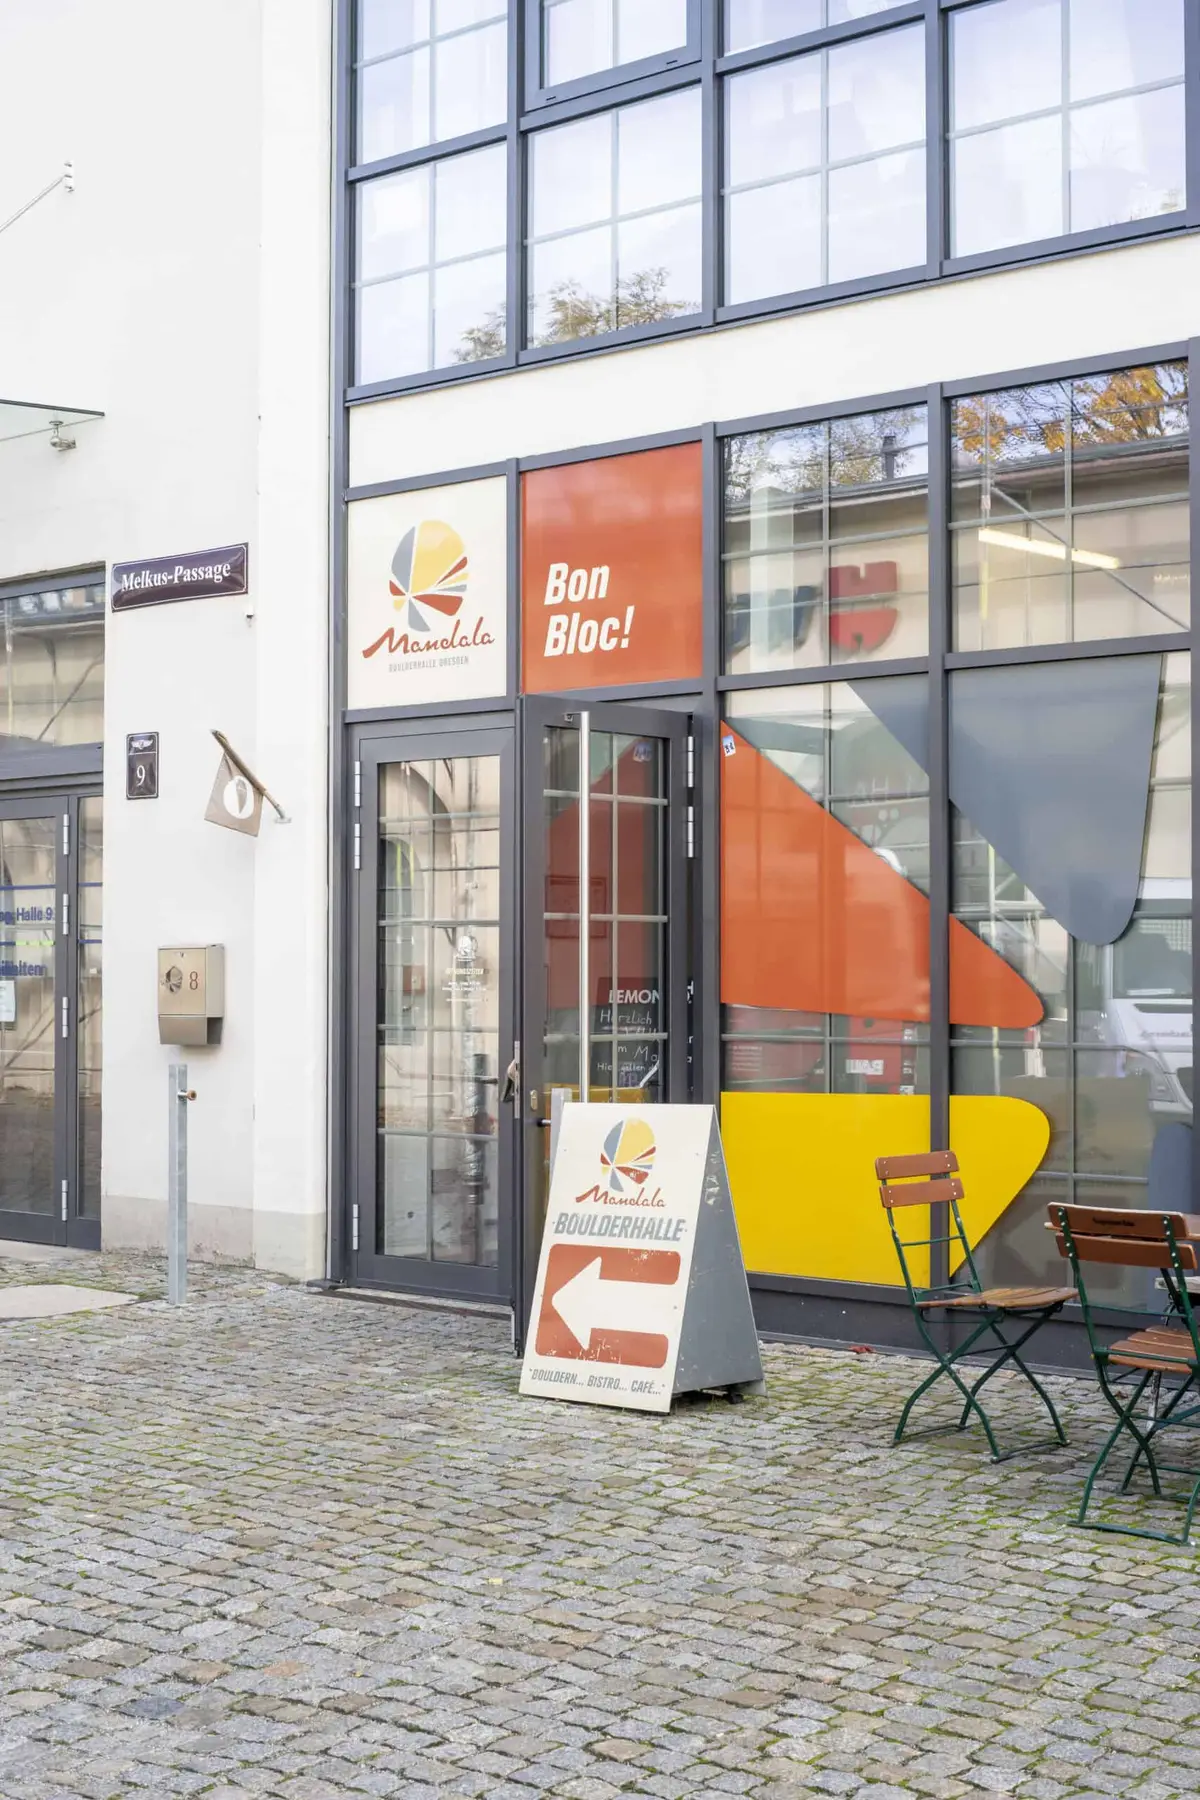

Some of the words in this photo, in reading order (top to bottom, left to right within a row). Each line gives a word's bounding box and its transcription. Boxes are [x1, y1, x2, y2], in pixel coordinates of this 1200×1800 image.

[121, 564, 231, 591] Melkus-Passage
[543, 562, 610, 606] Bon
[362, 616, 495, 658] Mandala
[543, 604, 635, 657] Bloc!
[136, 764, 146, 787] 9
[16, 906, 43, 921] Halle
[189, 970, 199, 991] 8
[600, 1008, 652, 1025] Hrzlich
[575, 1184, 667, 1208] Mandala
[554, 1212, 687, 1242] BOULDERHALLE
